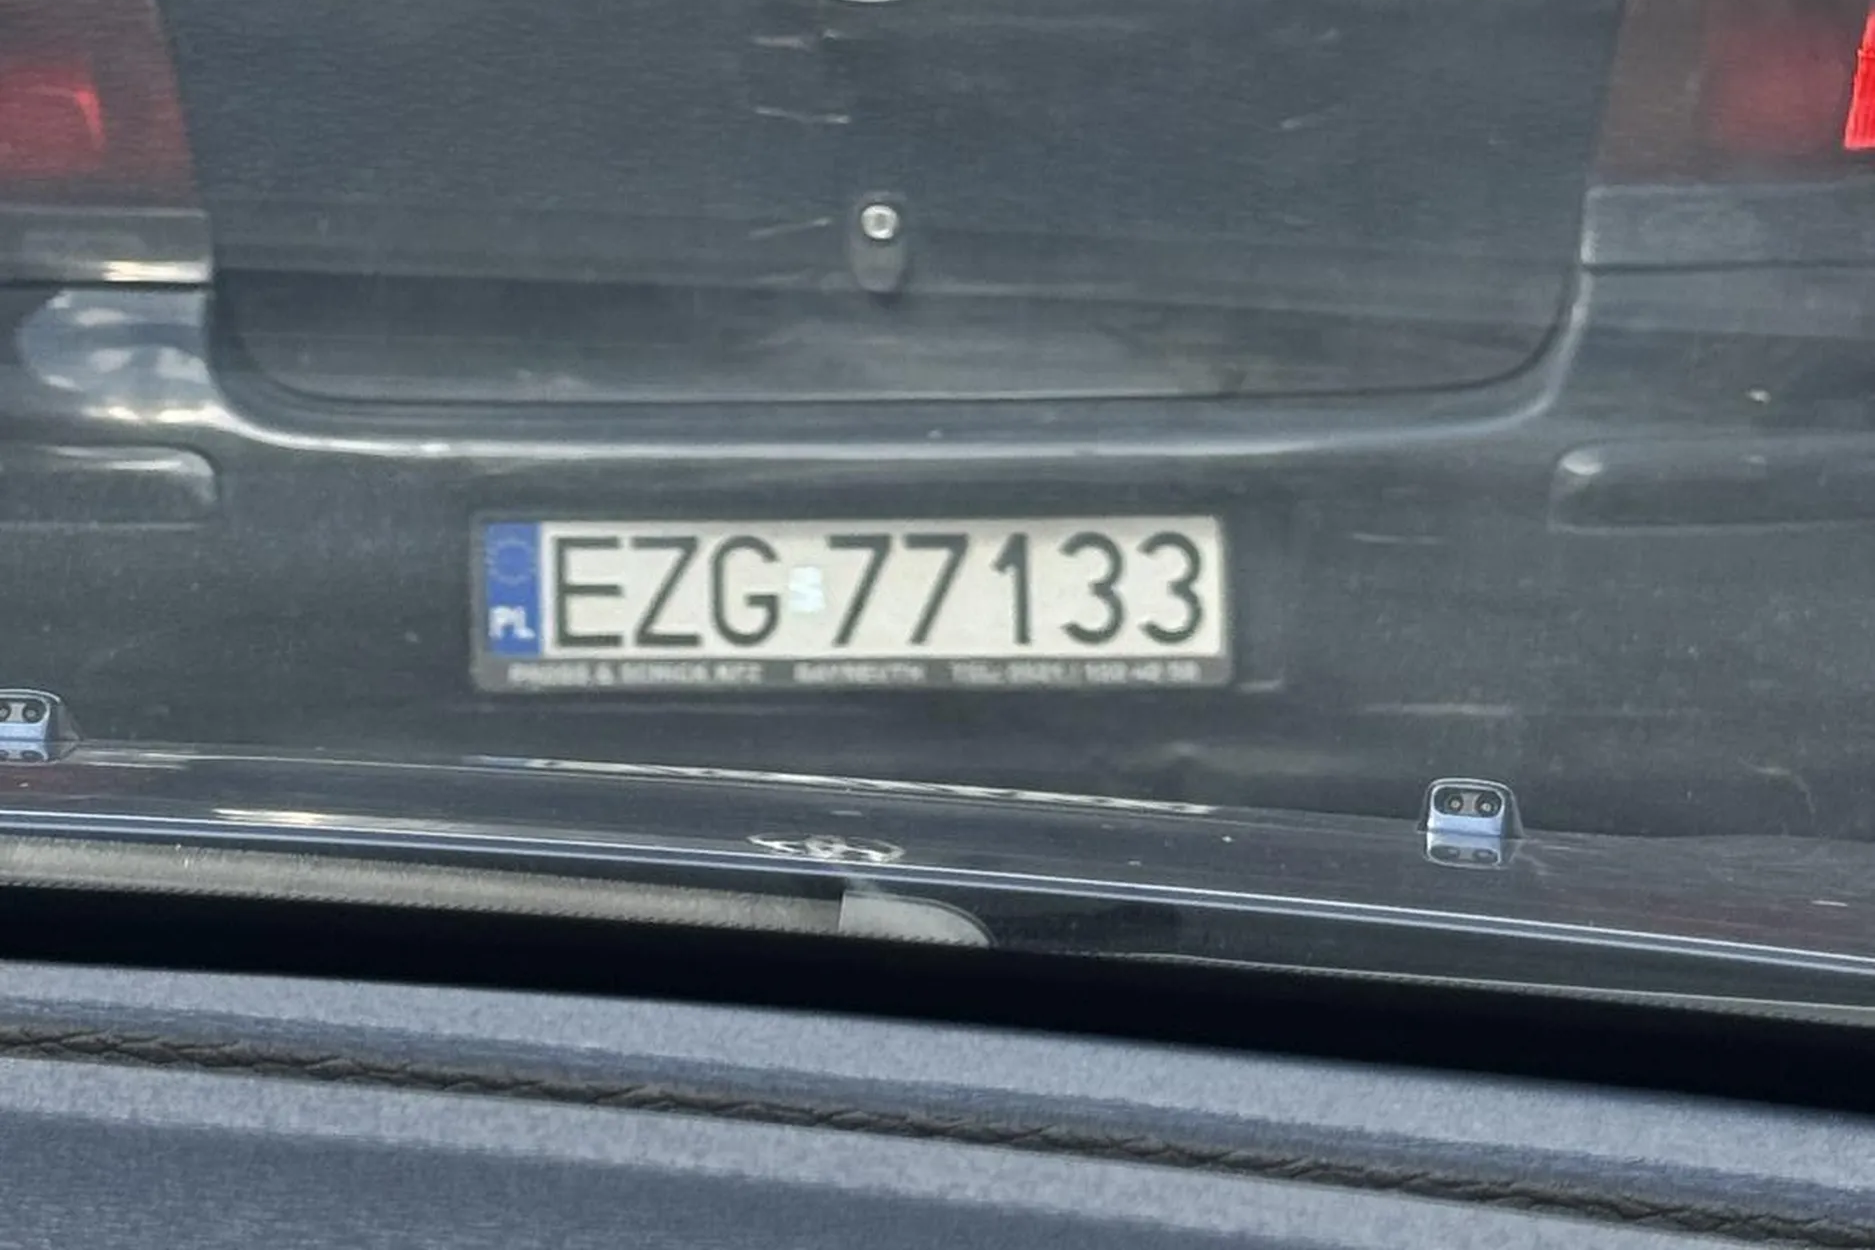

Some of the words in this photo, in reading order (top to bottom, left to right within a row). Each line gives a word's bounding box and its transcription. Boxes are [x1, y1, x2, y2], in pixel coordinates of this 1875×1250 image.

[488, 606, 536, 639] PL
[551, 534, 780, 648] EZG
[828, 532, 1206, 648] 77133
